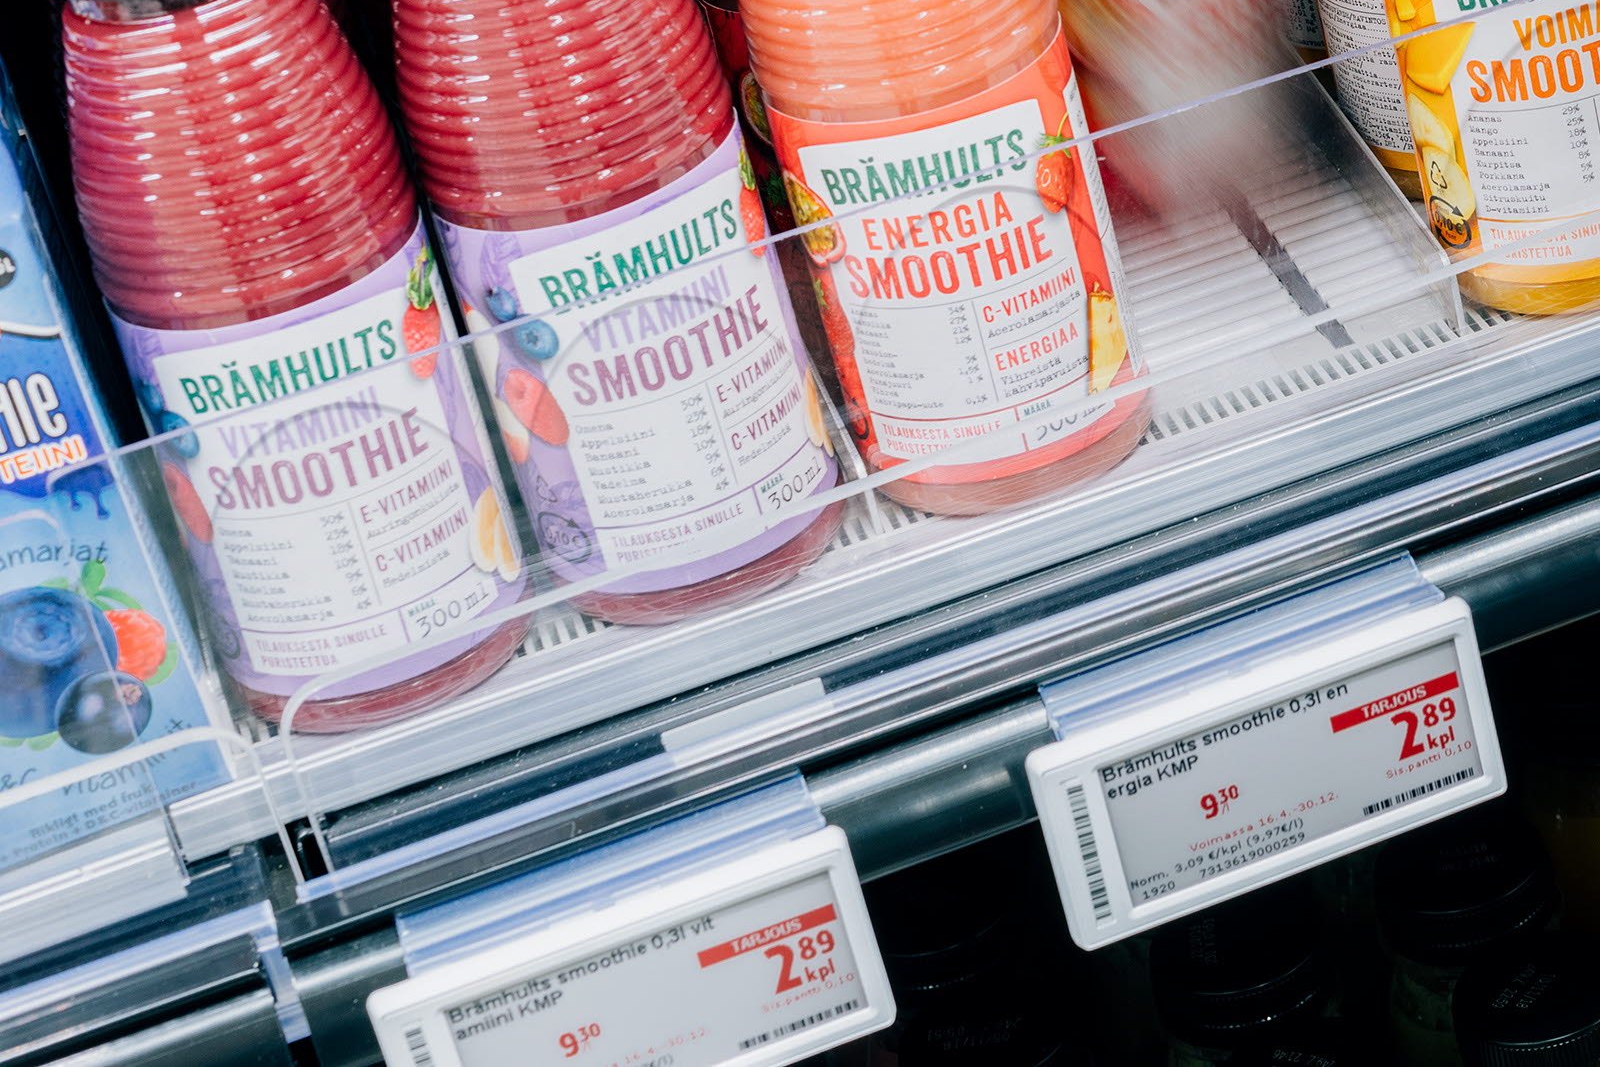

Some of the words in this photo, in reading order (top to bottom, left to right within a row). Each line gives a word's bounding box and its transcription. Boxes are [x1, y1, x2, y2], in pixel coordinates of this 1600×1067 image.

[1468, 114, 1502, 123] Ananas
[822, 129, 1027, 205] BRÄMHULTS
[1475, 148, 1515, 158] Banaani
[1477, 159, 1522, 170] Kurpitsa
[1479, 171, 1526, 181] Porkkana
[863, 192, 1013, 251] ENERGIA
[540, 199, 737, 313] BRÄMHULTS
[845, 214, 1053, 300] SMOOTHIE
[580, 265, 730, 352] VITAMIINI
[983, 267, 1076, 324] C-VITAMIINI
[180, 319, 397, 414] BRÄMHULTS
[567, 285, 768, 406] SMOOTHIE
[995, 323, 1079, 371] ENERGIAA
[716, 337, 787, 403] E-VITAMIINI
[217, 386, 382, 460] VITAMIINI
[731, 383, 802, 451] C-VITAMIINI
[208, 408, 429, 511] SMOOTHIE
[360, 460, 454, 523] E-VITAMIINI
[768, 479, 803, 510] 300
[376, 508, 469, 571] C-VITAMIINI
[416, 599, 462, 638] 300
[1361, 686, 1427, 720] TARJOUS
[1102, 737, 1198, 784] Brämhults
[1203, 705, 1286, 747] smoothie
[1327, 682, 1349, 699] en
[1427, 728, 1455, 751] kpl
[1445, 741, 1472, 758] 0,10
[1107, 774, 1153, 801] ergia
[1157, 756, 1200, 781] KMP
[1189, 822, 1254, 853] Voimassa
[1130, 871, 1169, 891] Norm.
[1175, 856, 1204, 874] 3,09
[1143, 880, 1176, 900] 1920
[731, 918, 802, 953] TARJOUS
[557, 943, 647, 985] smoothie
[804, 958, 835, 983] kpl
[456, 1009, 515, 1041] amiini
[519, 990, 563, 1018] KMP
